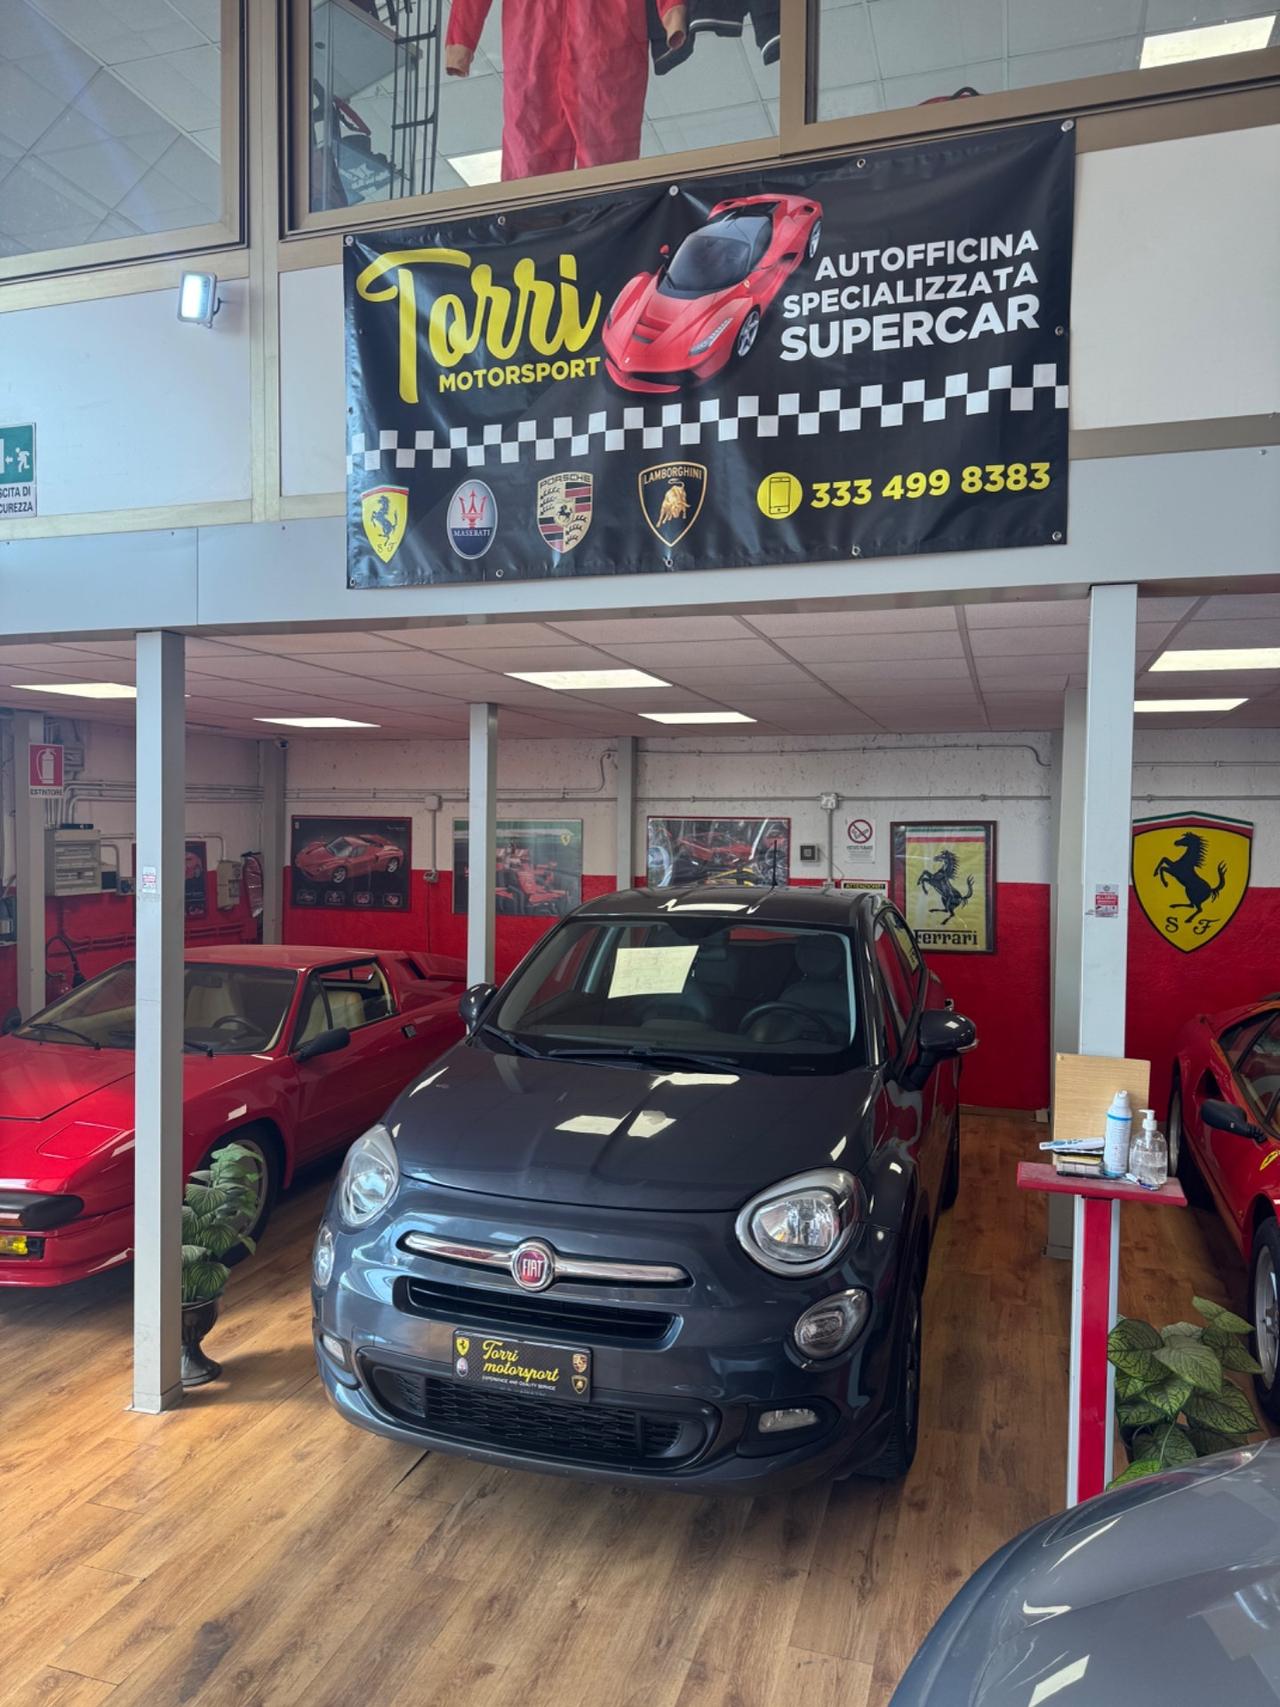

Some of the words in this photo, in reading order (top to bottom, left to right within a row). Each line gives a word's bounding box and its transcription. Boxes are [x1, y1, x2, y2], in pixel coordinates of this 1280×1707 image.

[814, 230, 1038, 281] AUTOFFICINA
[783, 262, 1038, 319] SPECIALIZZATA
[356, 248, 602, 404] Torri
[780, 294, 1040, 361] SUPERCAR
[438, 356, 601, 393] MOTORSPORT
[540, 473, 591, 488] PORSCHE
[643, 465, 703, 486] LAMBORGHINI
[810, 479, 872, 509] 333
[882, 468, 951, 502] 499
[961, 462, 1051, 495] 8383
[22, 486, 31, 497] DI
[453, 528, 491, 537] MASERATI
[1165, 916, 1179, 933] S
[913, 929, 979, 945] Ferrari
[522, 1258, 544, 1278] FIAT
[482, 1340, 519, 1362] Torri
[483, 1361, 560, 1383] motorsport
